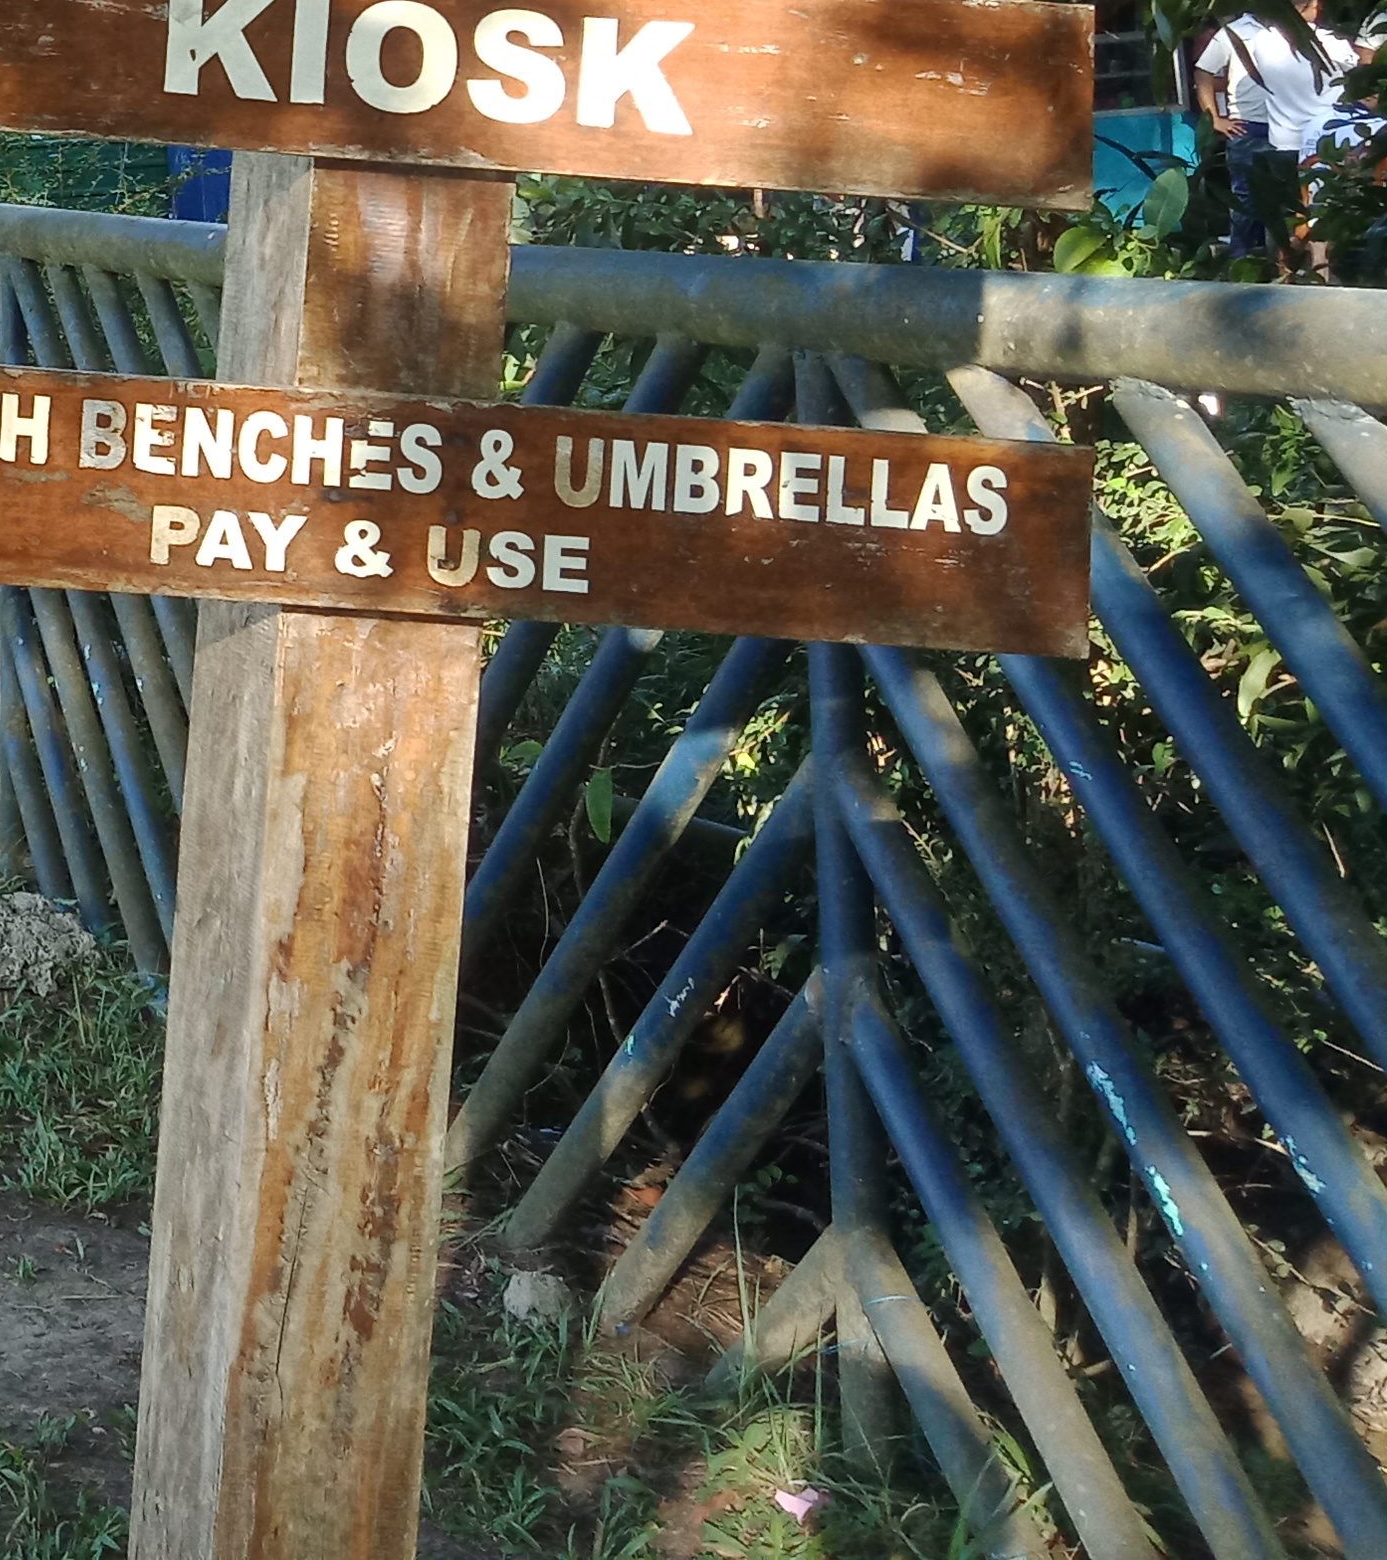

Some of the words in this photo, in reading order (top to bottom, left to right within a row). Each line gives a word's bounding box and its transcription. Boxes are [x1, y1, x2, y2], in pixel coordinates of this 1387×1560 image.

[79, 399, 443, 494] BENCHES
[470, 429, 525, 501] &
[554, 435, 1009, 536] UMBRELLAS
[149, 505, 308, 572] PAY
[334, 520, 394, 578] &
[426, 526, 591, 594] USE
